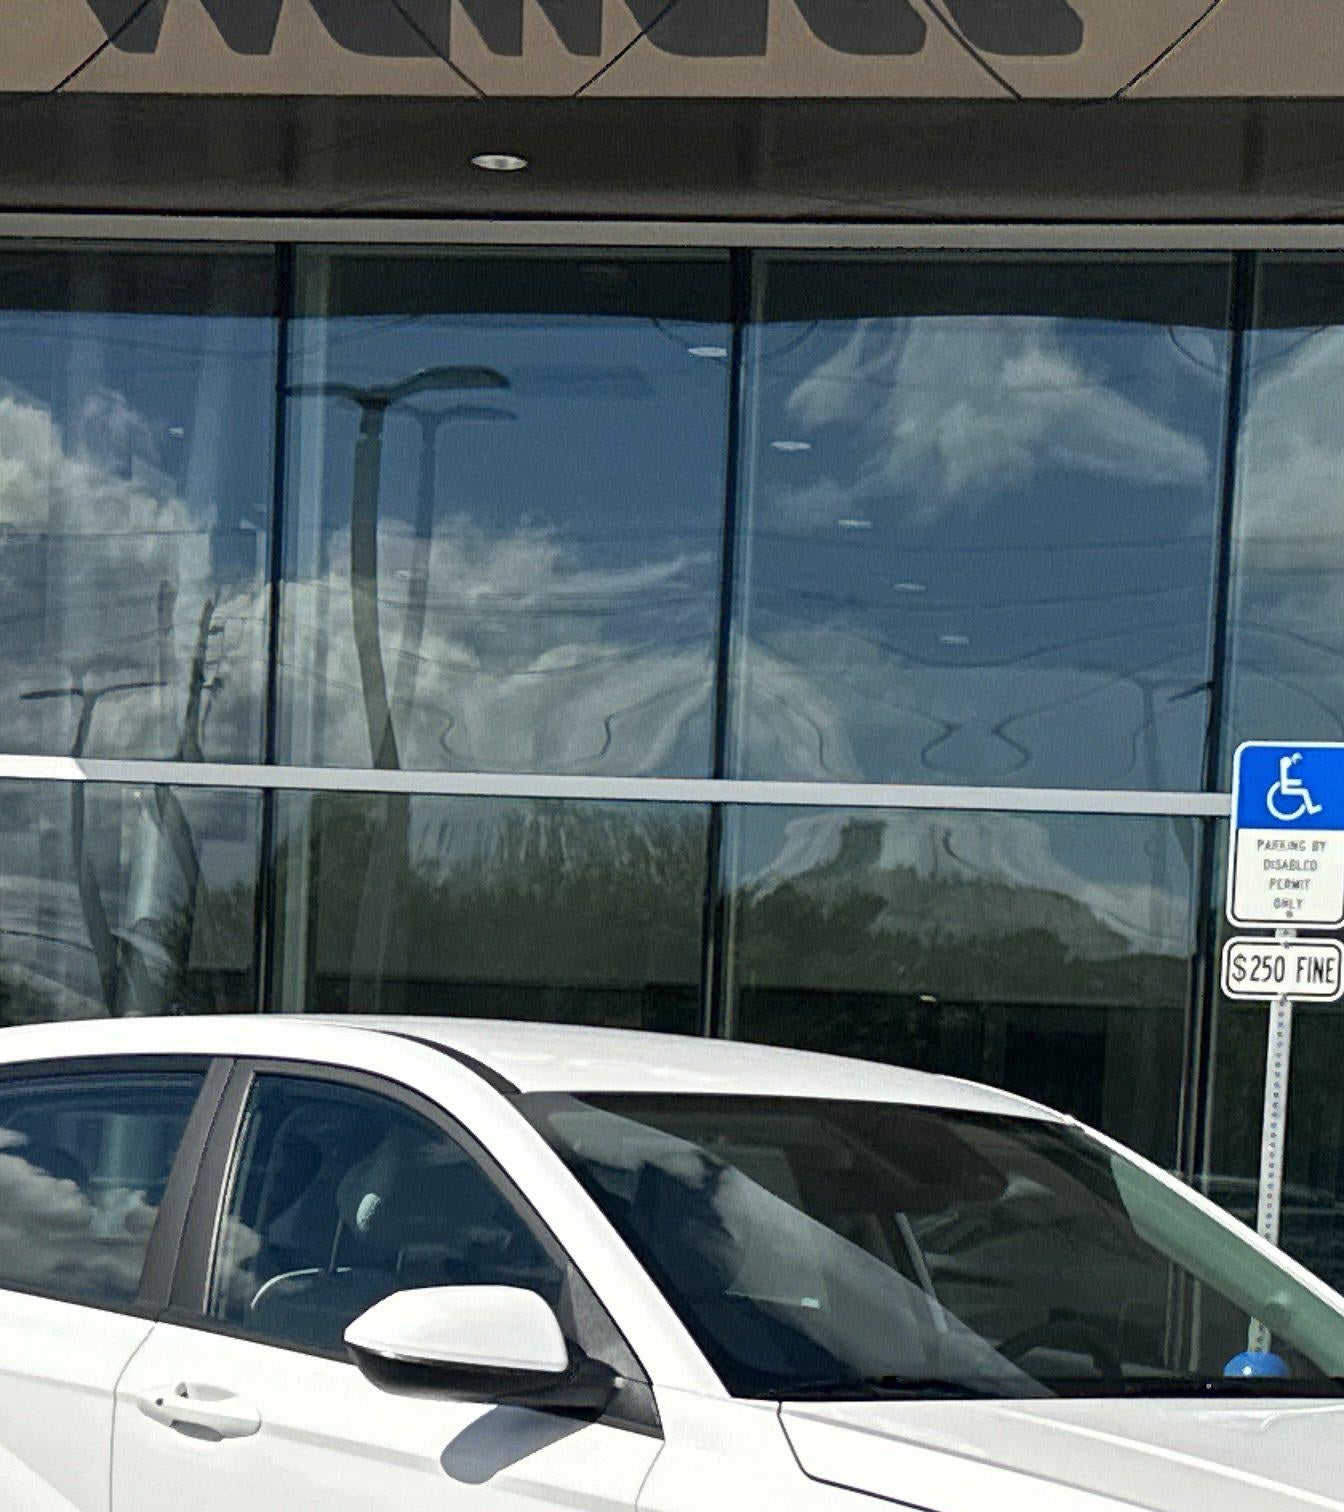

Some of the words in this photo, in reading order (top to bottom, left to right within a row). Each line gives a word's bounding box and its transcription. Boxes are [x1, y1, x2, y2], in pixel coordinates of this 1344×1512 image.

[1257, 839, 1306, 852] PARKING
[1312, 841, 1326, 852] BY
[1263, 859, 1318, 872] DISABLED
[1268, 878, 1311, 891] PERMIT
[1273, 898, 1303, 910] ONLY
[1232, 953, 1285, 984] $250
[1295, 956, 1336, 984] FINE
